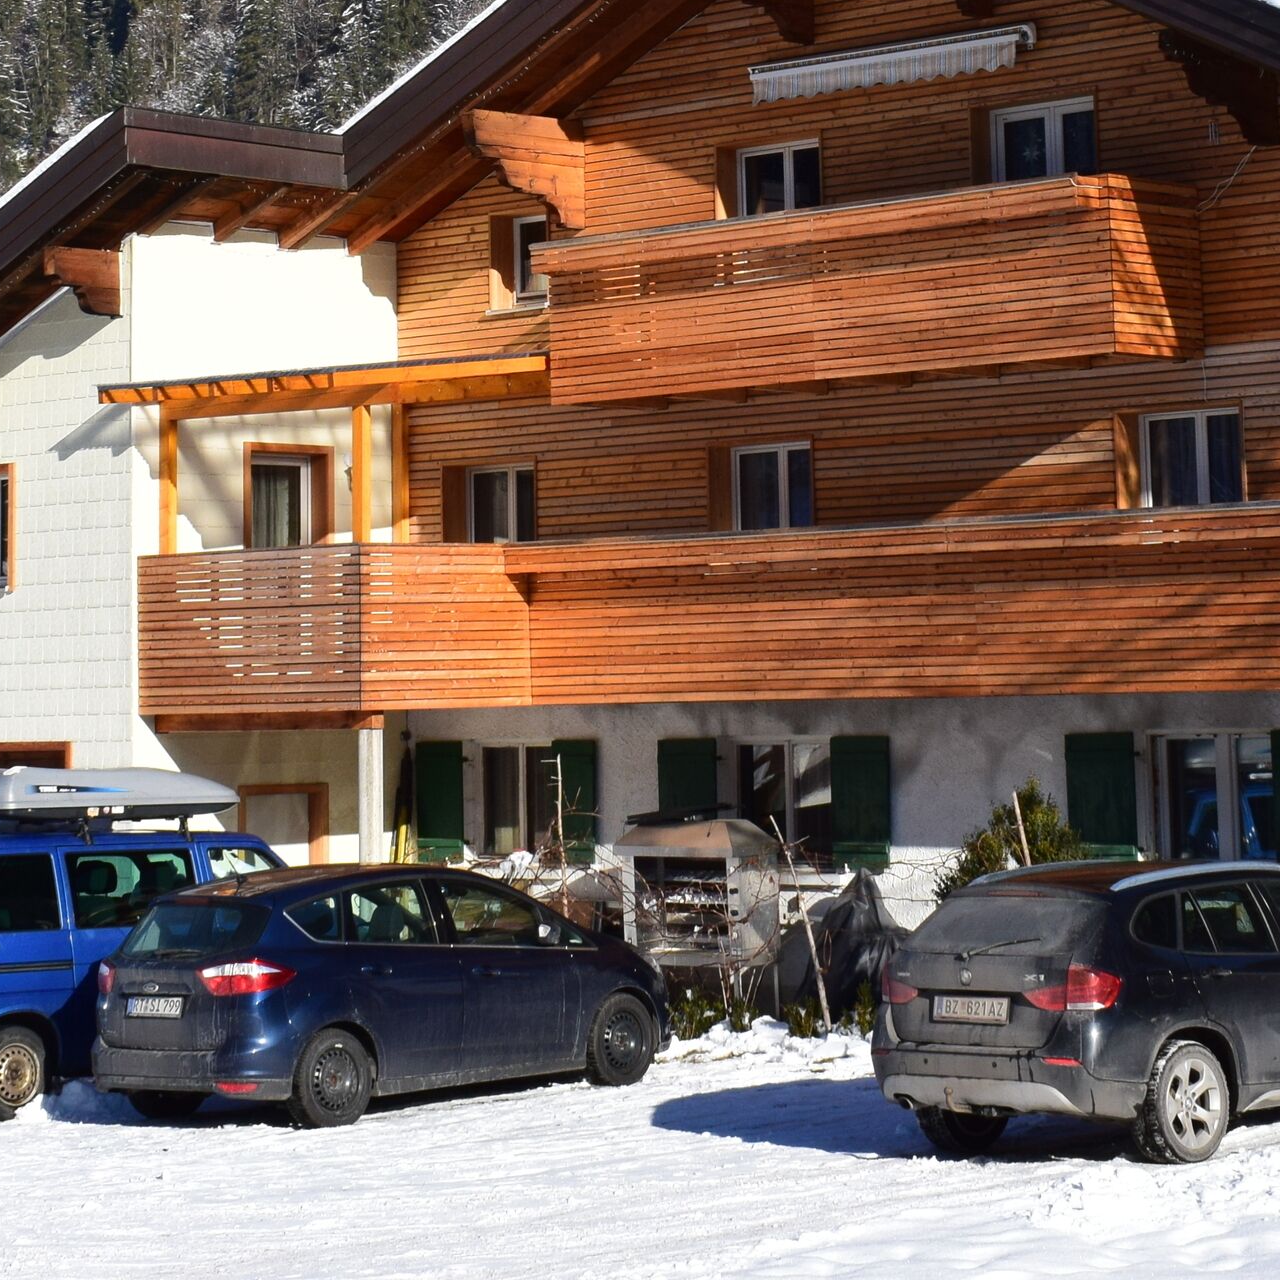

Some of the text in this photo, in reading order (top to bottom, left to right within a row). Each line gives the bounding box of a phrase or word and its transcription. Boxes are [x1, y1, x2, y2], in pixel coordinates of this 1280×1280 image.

[134, 998, 146, 1013] RT
[163, 999, 181, 1013] 799
[944, 998, 1005, 1017] BZ 621AZ
